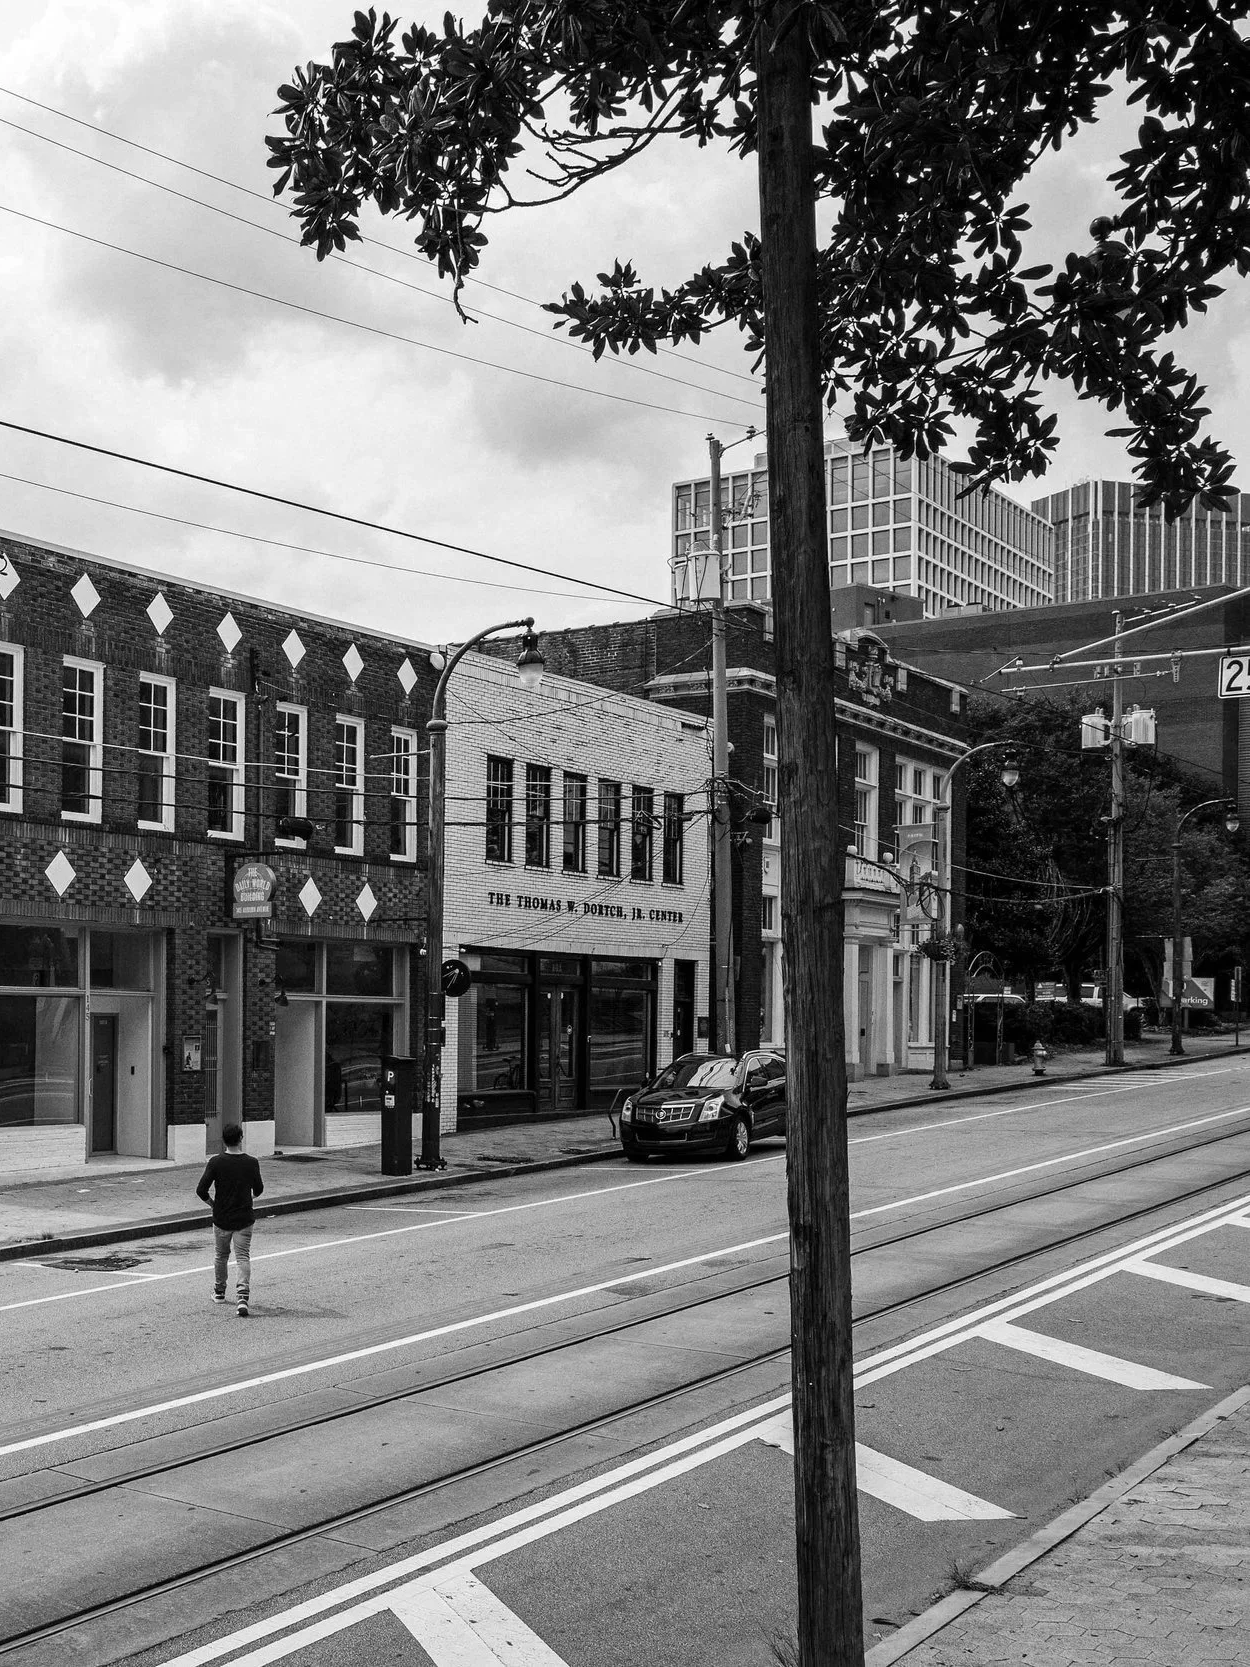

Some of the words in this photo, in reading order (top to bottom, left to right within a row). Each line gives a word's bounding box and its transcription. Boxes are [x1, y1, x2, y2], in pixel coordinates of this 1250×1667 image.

[488, 892, 511, 906] THE
[517, 895, 562, 913] THOMAS
[567, 901, 578, 913] W.
[583, 903, 627, 920] DORTCH,
[632, 907, 645, 920] JR.
[649, 909, 684, 923] CENTER
[387, 1071, 395, 1081] P
